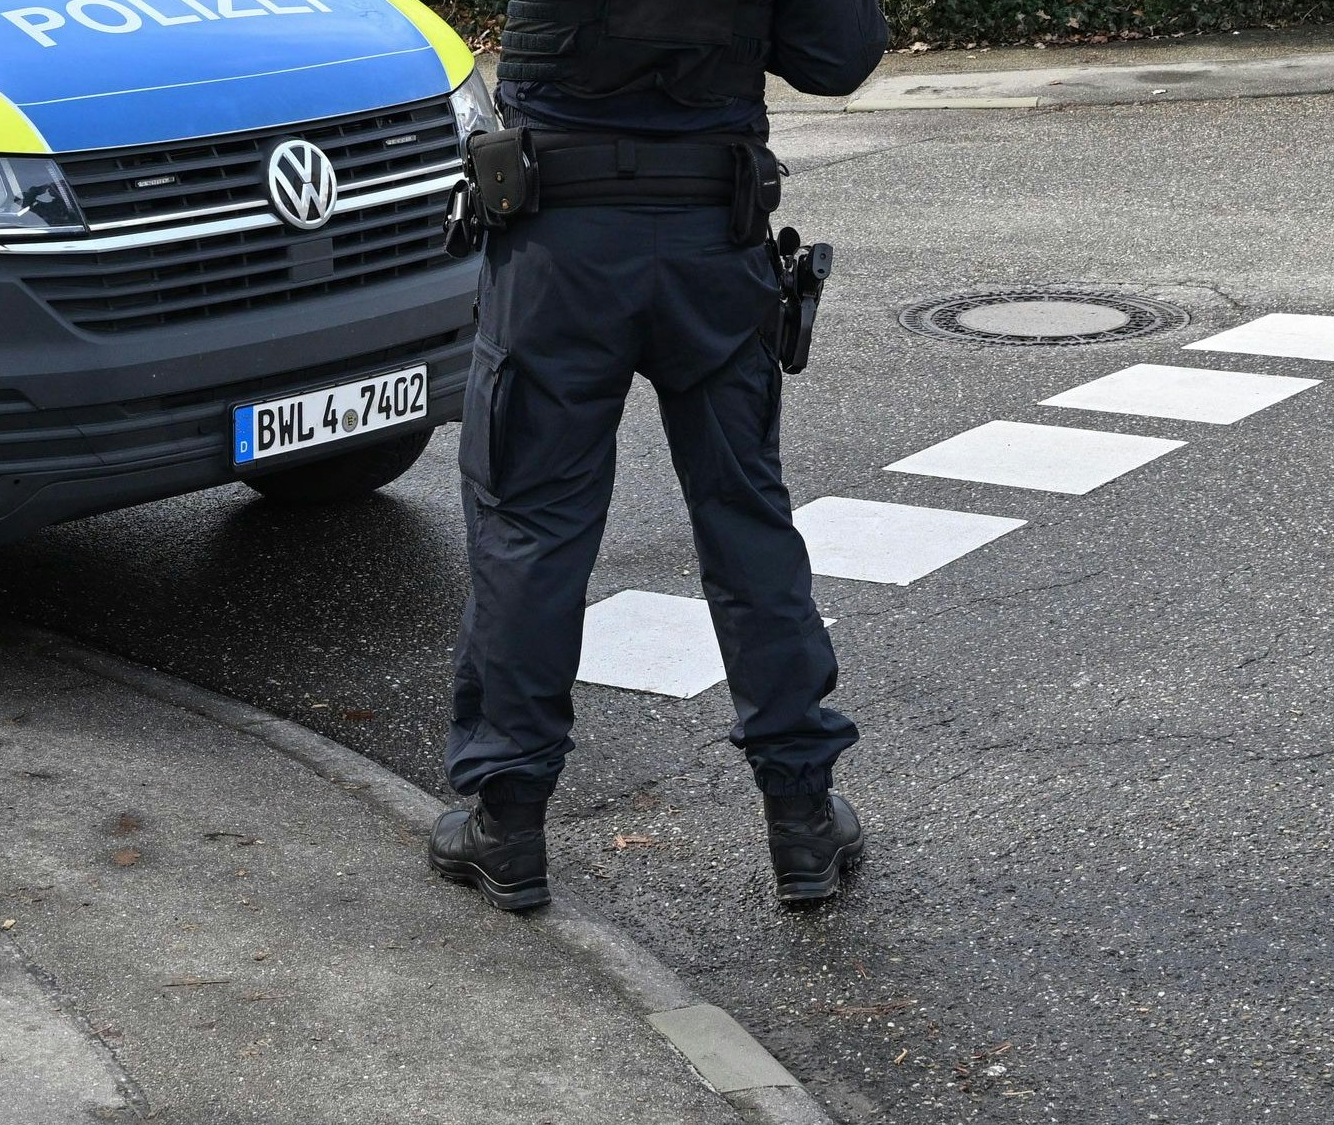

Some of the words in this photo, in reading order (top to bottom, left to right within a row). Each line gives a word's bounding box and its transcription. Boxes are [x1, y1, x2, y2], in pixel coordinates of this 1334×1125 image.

[257, 401, 315, 452] BWL
[322, 394, 338, 434] 4
[360, 372, 424, 426] 7402
[240, 440, 248, 453] D
